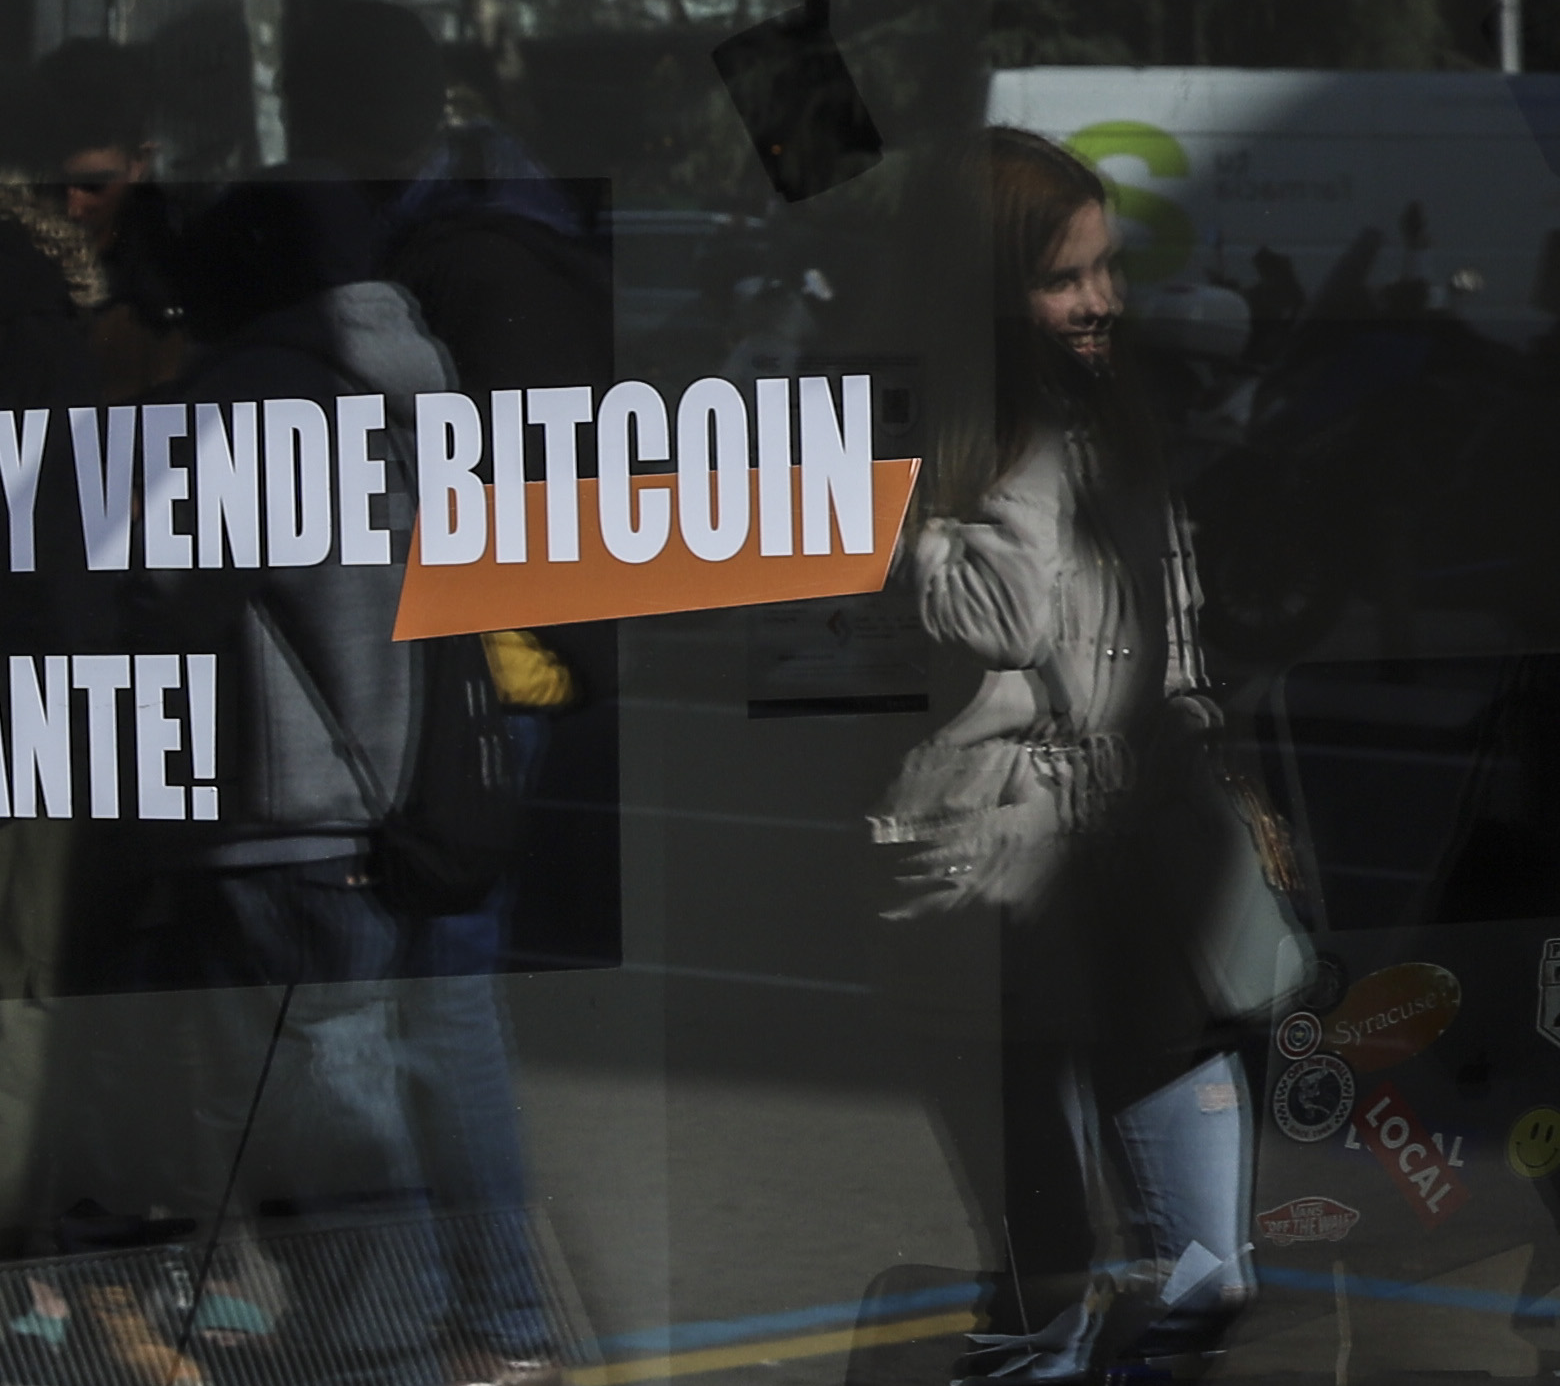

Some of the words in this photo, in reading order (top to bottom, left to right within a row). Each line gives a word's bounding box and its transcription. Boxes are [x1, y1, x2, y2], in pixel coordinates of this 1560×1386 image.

[67, 393, 392, 573] VENDE
[414, 374, 874, 567] BITCOIN
[1332, 991, 1439, 1046] Syracuse
[1364, 1096, 1452, 1214] LOCAL
